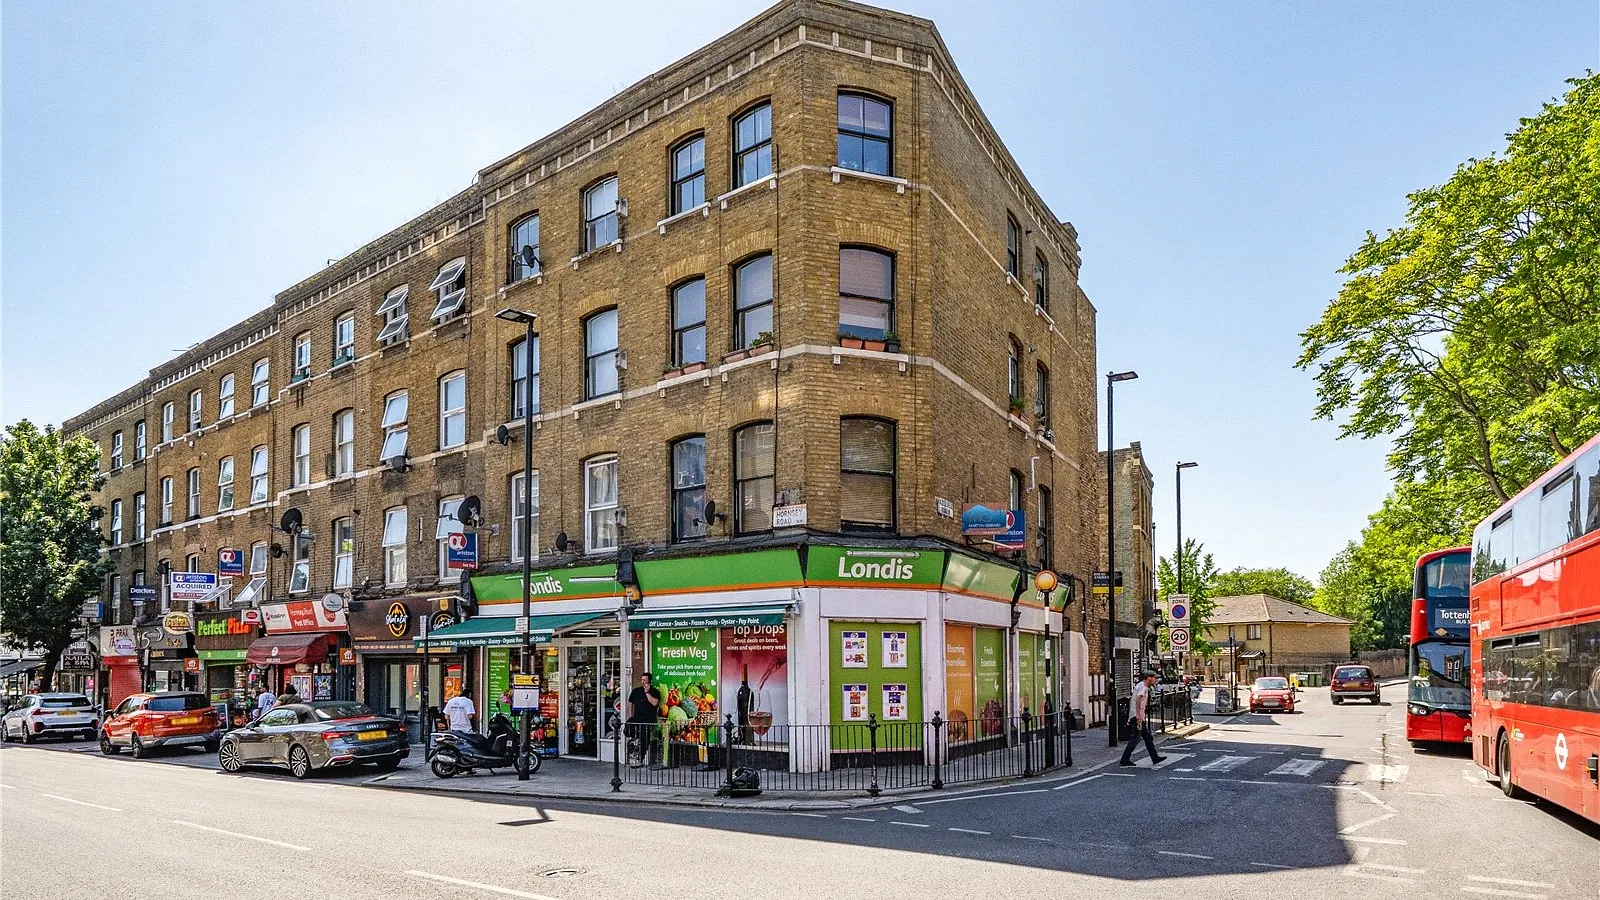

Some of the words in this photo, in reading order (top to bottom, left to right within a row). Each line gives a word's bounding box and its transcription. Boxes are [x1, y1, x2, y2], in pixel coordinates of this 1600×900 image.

[776, 509, 803, 518] HORNSEY
[838, 556, 913, 580] Londis
[198, 620, 227, 636] Perfect
[228, 618, 251, 634] Pizza
[754, 624, 784, 638] Drops
[670, 629, 700, 643] Lovely
[662, 646, 686, 658] Fresh
[689, 646, 708, 661] Veg
